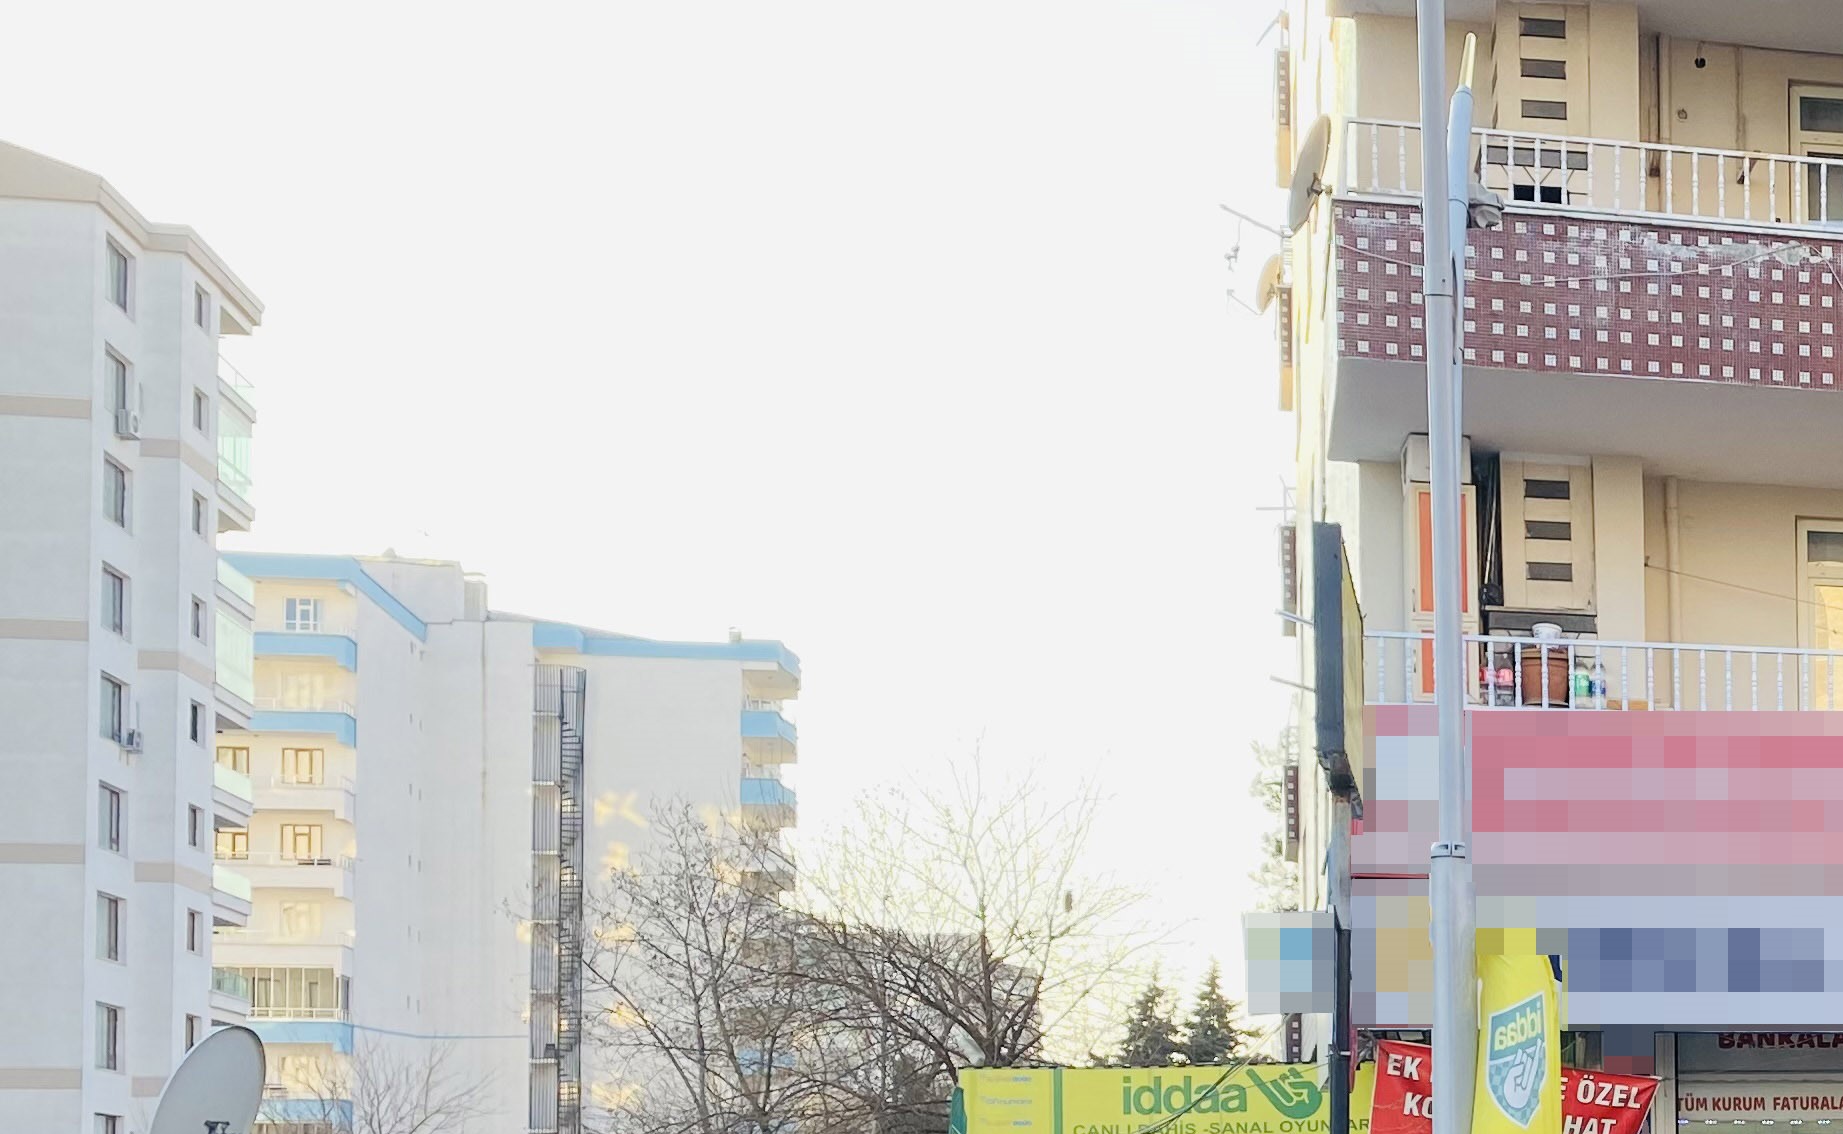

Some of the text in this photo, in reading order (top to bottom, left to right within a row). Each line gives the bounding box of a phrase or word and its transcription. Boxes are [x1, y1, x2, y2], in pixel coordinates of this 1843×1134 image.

[1387, 1053, 1422, 1081] EK
[1122, 1075, 1248, 1115] iddaa
[1577, 1074, 1641, 1109] ÖZEL
[1678, 1092, 1708, 1111] TÜM
[1712, 1096, 1765, 1111] KURUM
[1279, 1119, 1369, 1134] OYUNAR
